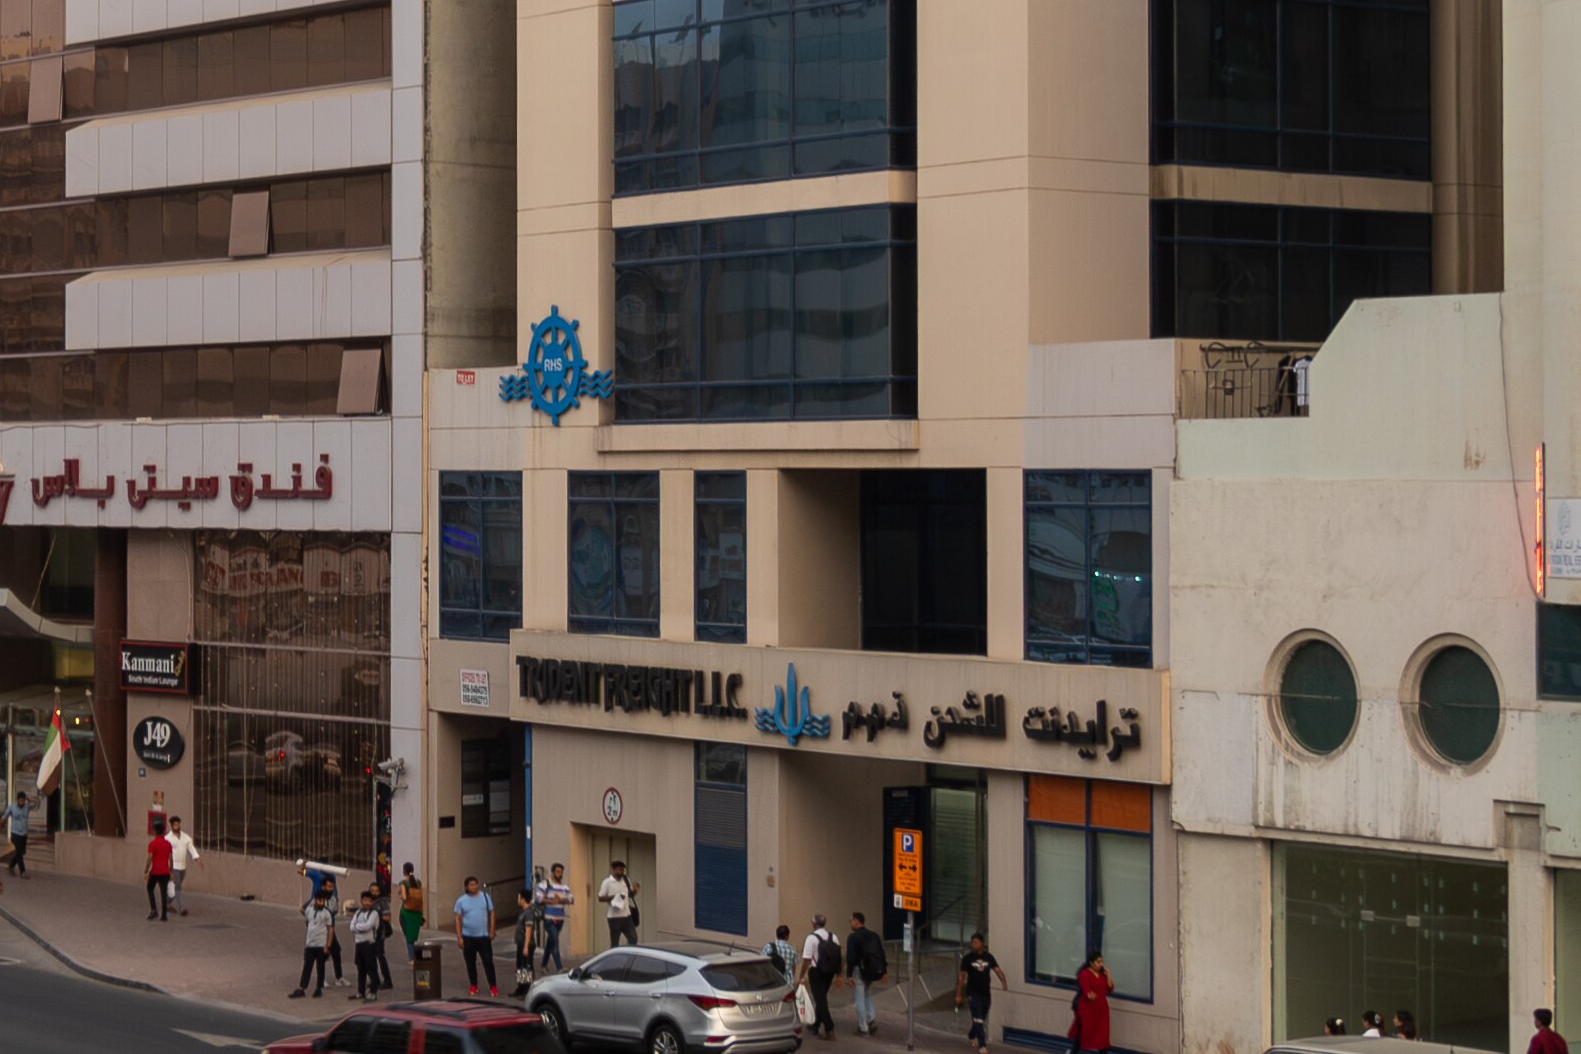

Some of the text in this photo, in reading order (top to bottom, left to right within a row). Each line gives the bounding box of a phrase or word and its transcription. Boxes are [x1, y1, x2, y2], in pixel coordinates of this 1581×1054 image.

[544, 358, 563, 372] RHS
[230, 453, 334, 511] فندق
[121, 651, 176, 674] Kanmani
[128, 674, 179, 687] South Indian Lounge
[516, 655, 602, 704] TRIDENT
[603, 663, 693, 717] FREIGHT
[923, 690, 1007, 748] للشحن
[1022, 699, 1141, 763] ترايدنت
[143, 721, 171, 748] J49
[903, 834, 912, 852] P
